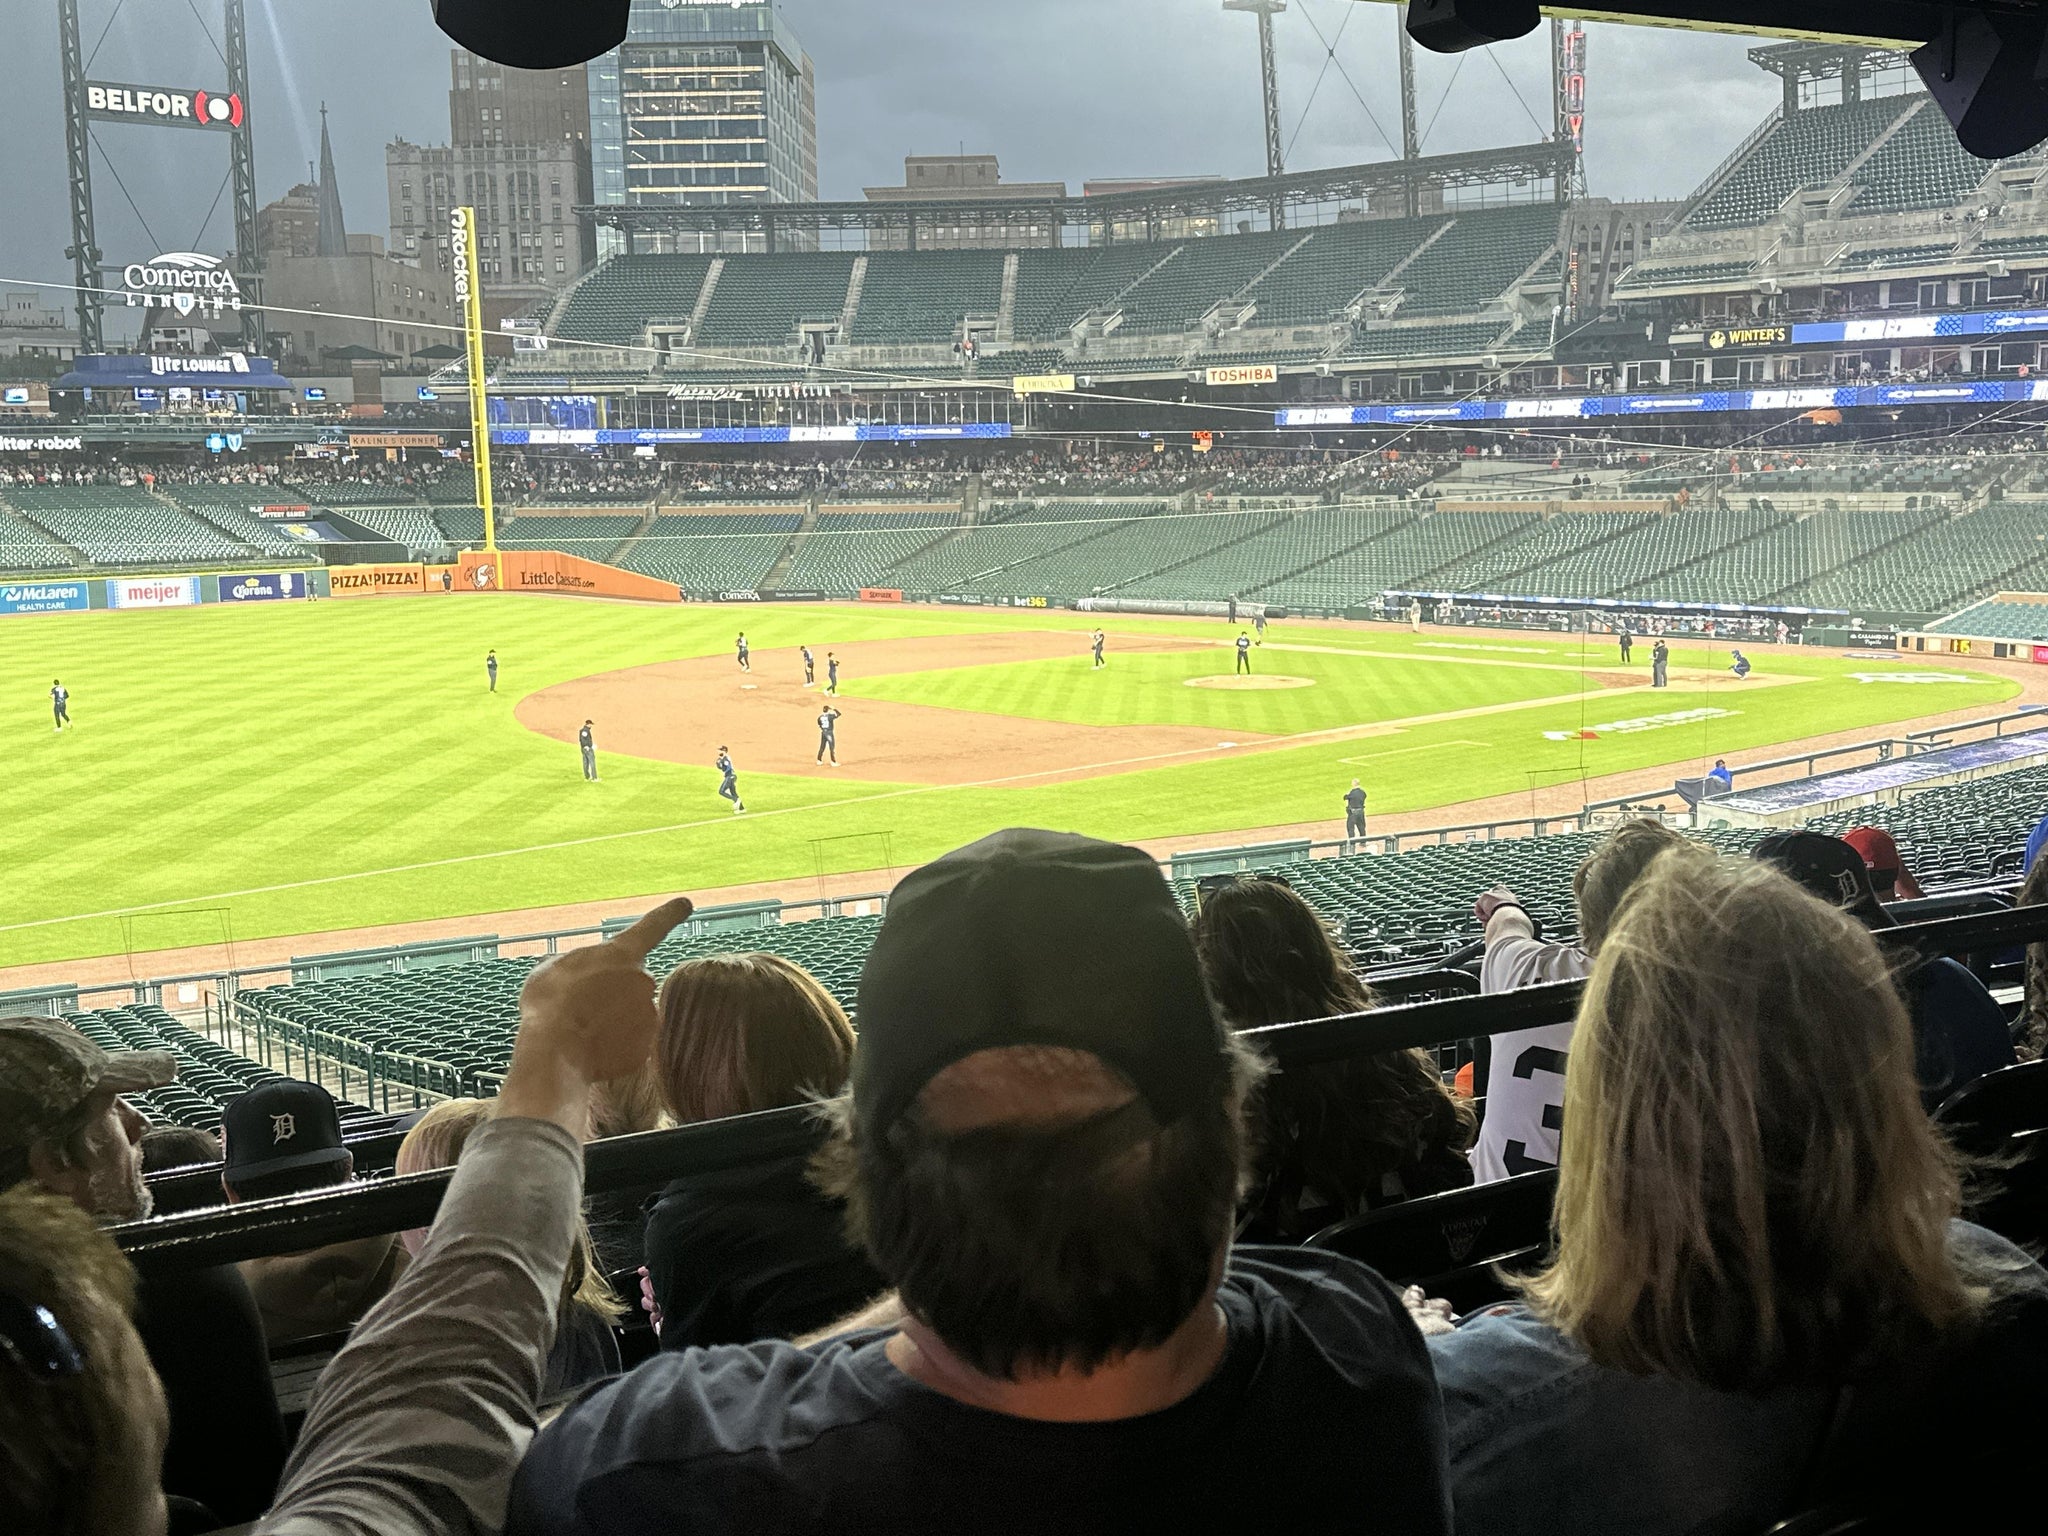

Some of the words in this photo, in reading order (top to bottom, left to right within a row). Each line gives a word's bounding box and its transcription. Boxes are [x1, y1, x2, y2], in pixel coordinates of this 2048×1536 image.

[87, 86, 190, 117] BELFOR
[451, 228, 473, 303] Rocket
[1728, 327, 1786, 344] WINTER'S
[182, 358, 231, 373] LOUNGE
[1210, 368, 1273, 382] TOSHIBA
[754, 386, 790, 398] TIGER
[802, 385, 831, 398] CLUB
[353, 437, 397, 445] KALINES
[400, 436, 435, 444] CORNER
[331, 574, 373, 589] PIZZA!
[374, 572, 419, 586] PIZZA!
[520, 570, 554, 586] Little
[22, 586, 78, 601] McLaren
[128, 582, 181, 602] meijer
[232, 584, 273, 599] Corona
[16, 603, 45, 611] HEALTH
[46, 602, 66, 610] CARE
[1014, 595, 1047, 608] bet365
[270, 1112, 297, 1145] D
